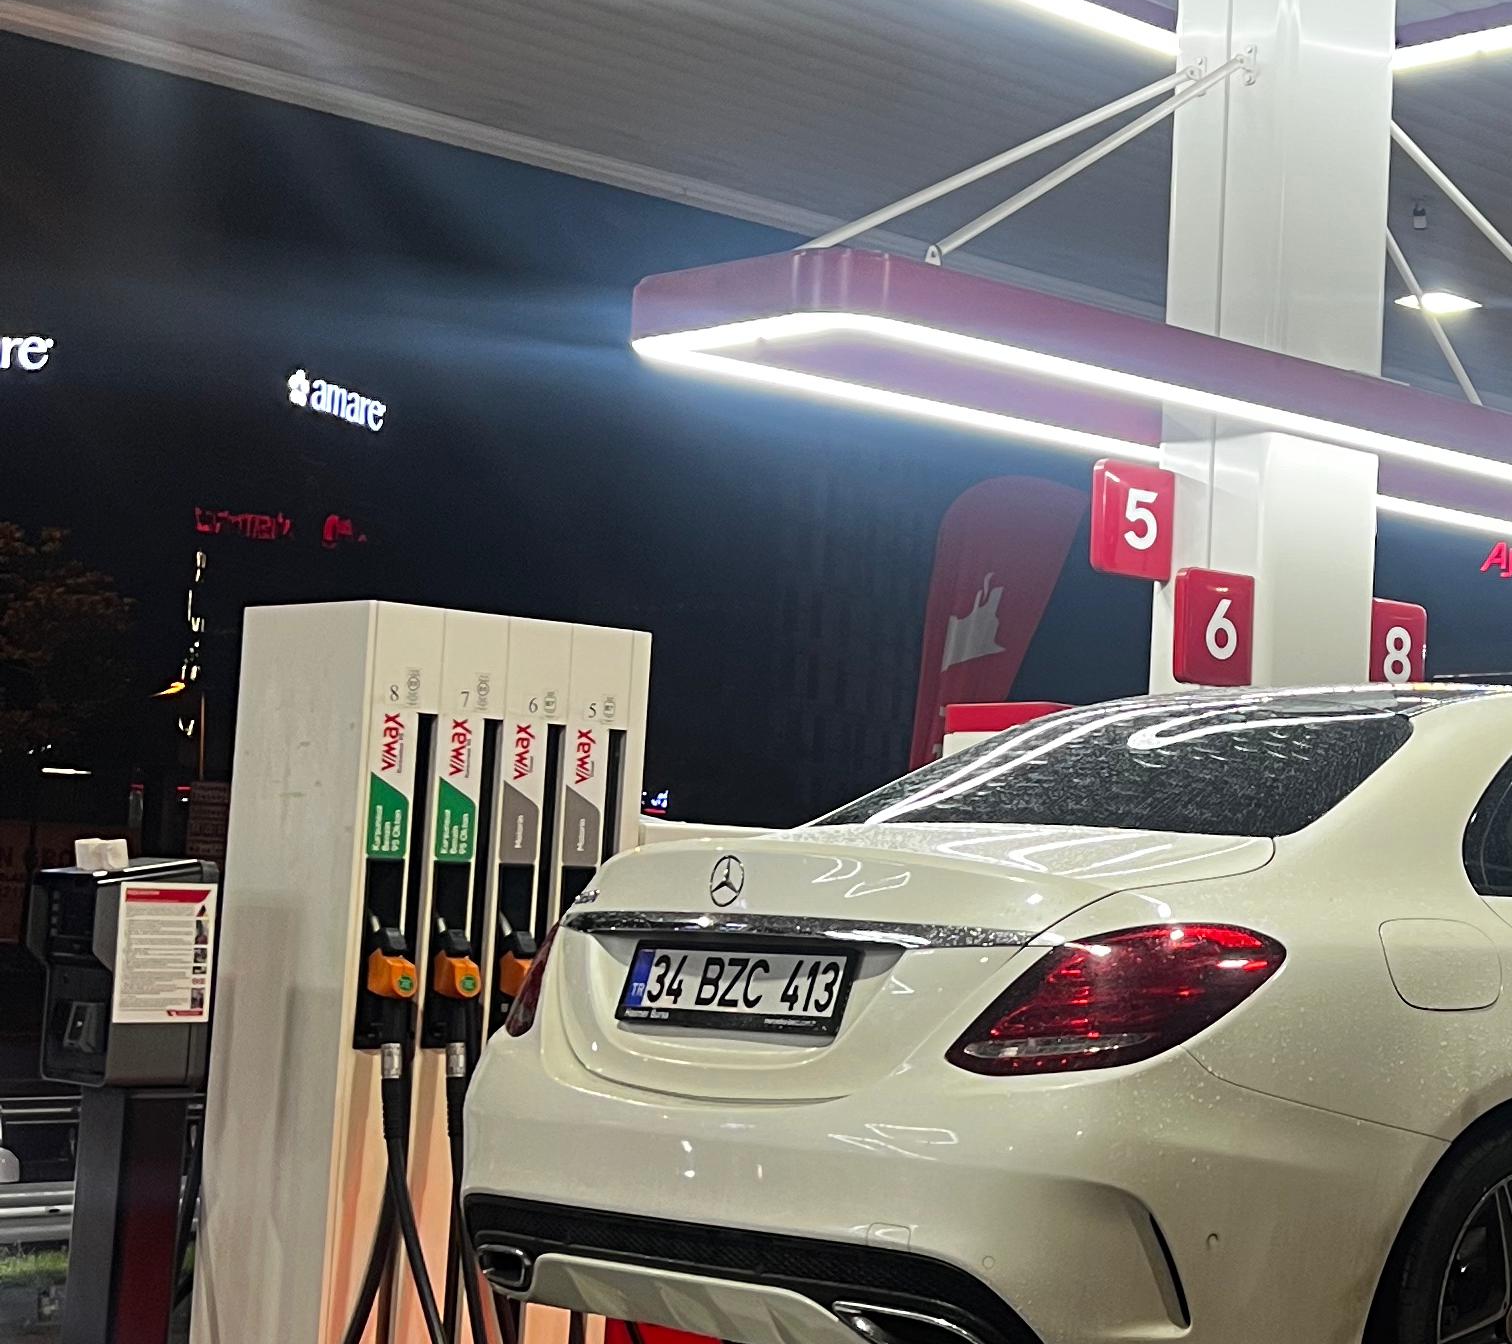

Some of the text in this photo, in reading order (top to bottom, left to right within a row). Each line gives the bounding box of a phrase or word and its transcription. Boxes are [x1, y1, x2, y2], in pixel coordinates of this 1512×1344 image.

[309, 379, 387, 432] amare
[1124, 488, 1158, 550] 5
[1205, 598, 1238, 660] 6
[1383, 626, 1412, 683] 8
[389, 684, 400, 702] 8
[460, 690, 470, 708] 7
[528, 697, 539, 714] 6
[588, 702, 597, 719] 5
[631, 954, 841, 1013] TR 34 BZC 413
